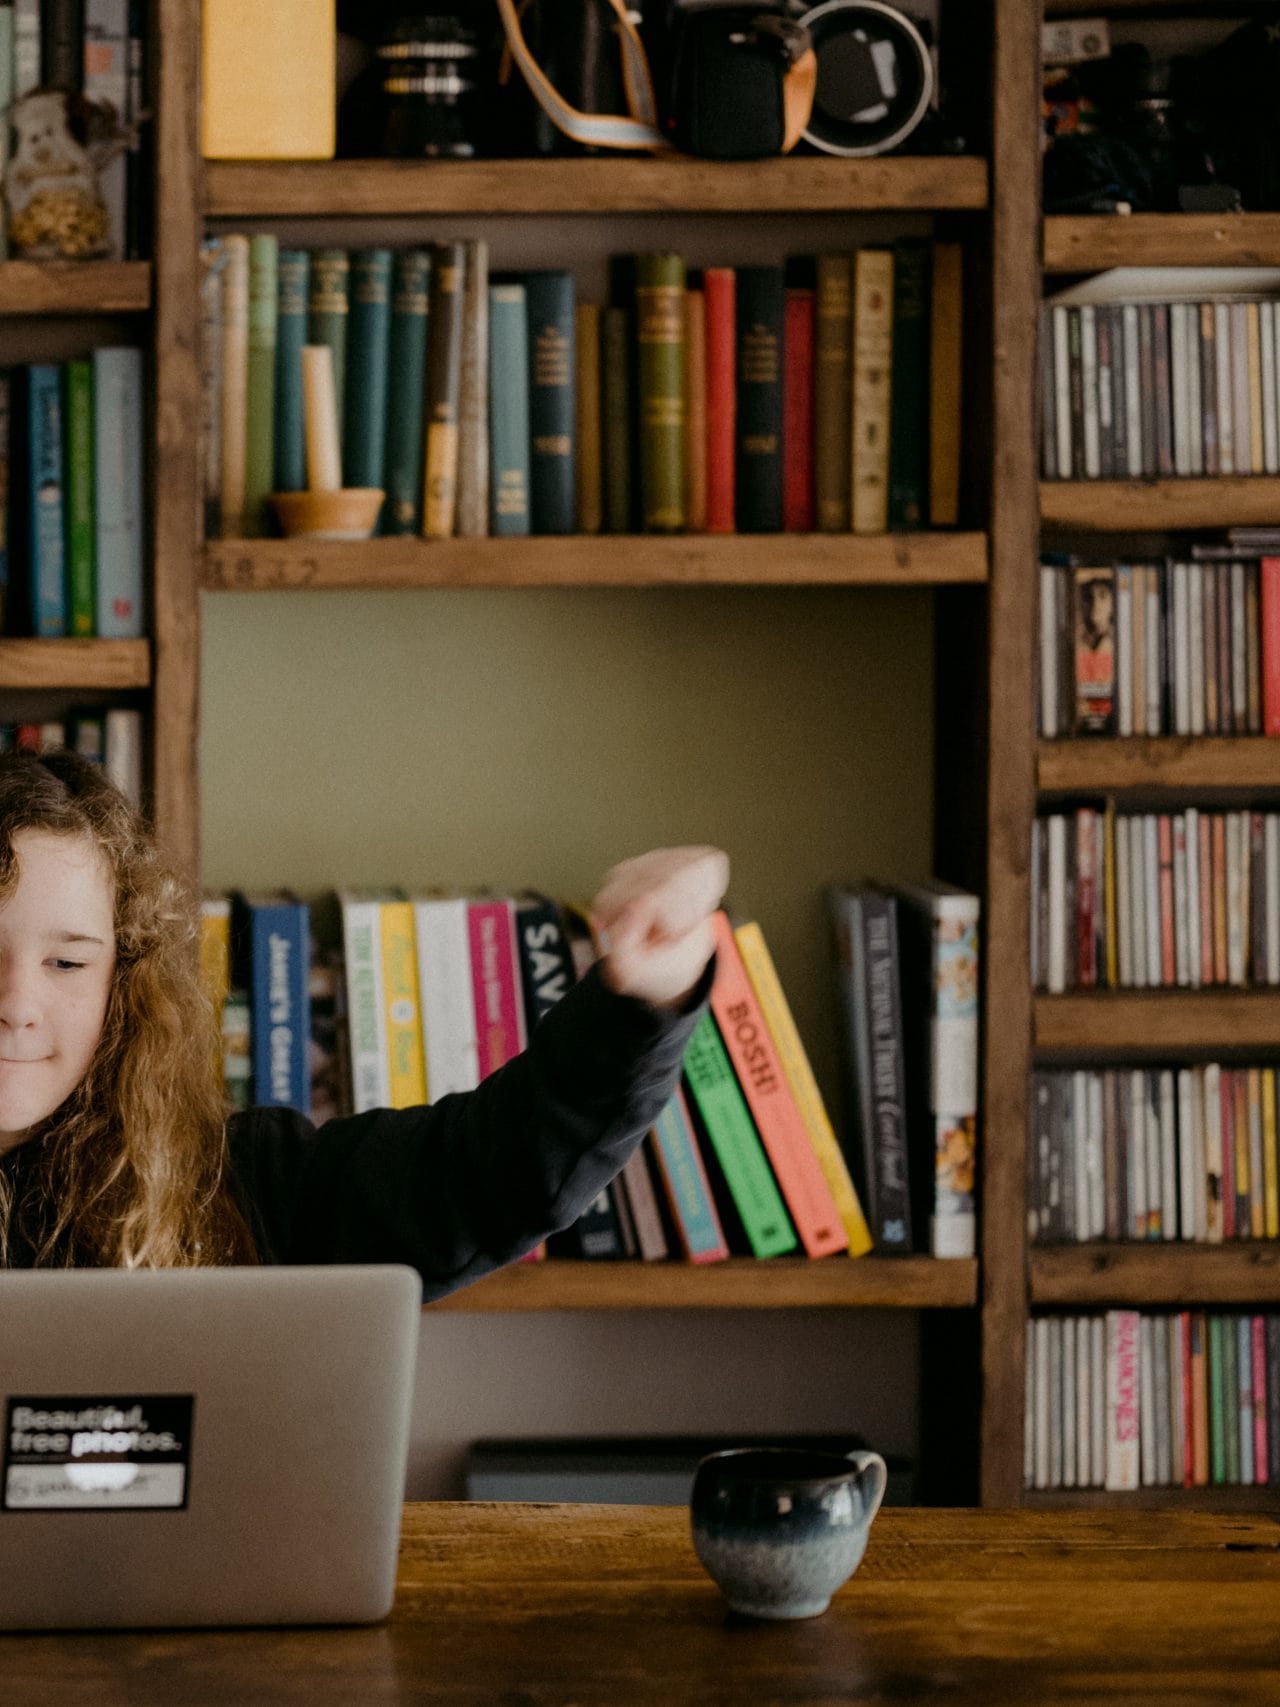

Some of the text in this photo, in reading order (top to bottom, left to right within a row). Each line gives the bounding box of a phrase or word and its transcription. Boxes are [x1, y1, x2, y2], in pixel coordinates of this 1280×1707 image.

[525, 922, 567, 1016] SAV
[726, 1000, 780, 1096] BOSH!
[11, 1431, 182, 1457] free photos.
[12, 1405, 149, 1431] Beautiful,
